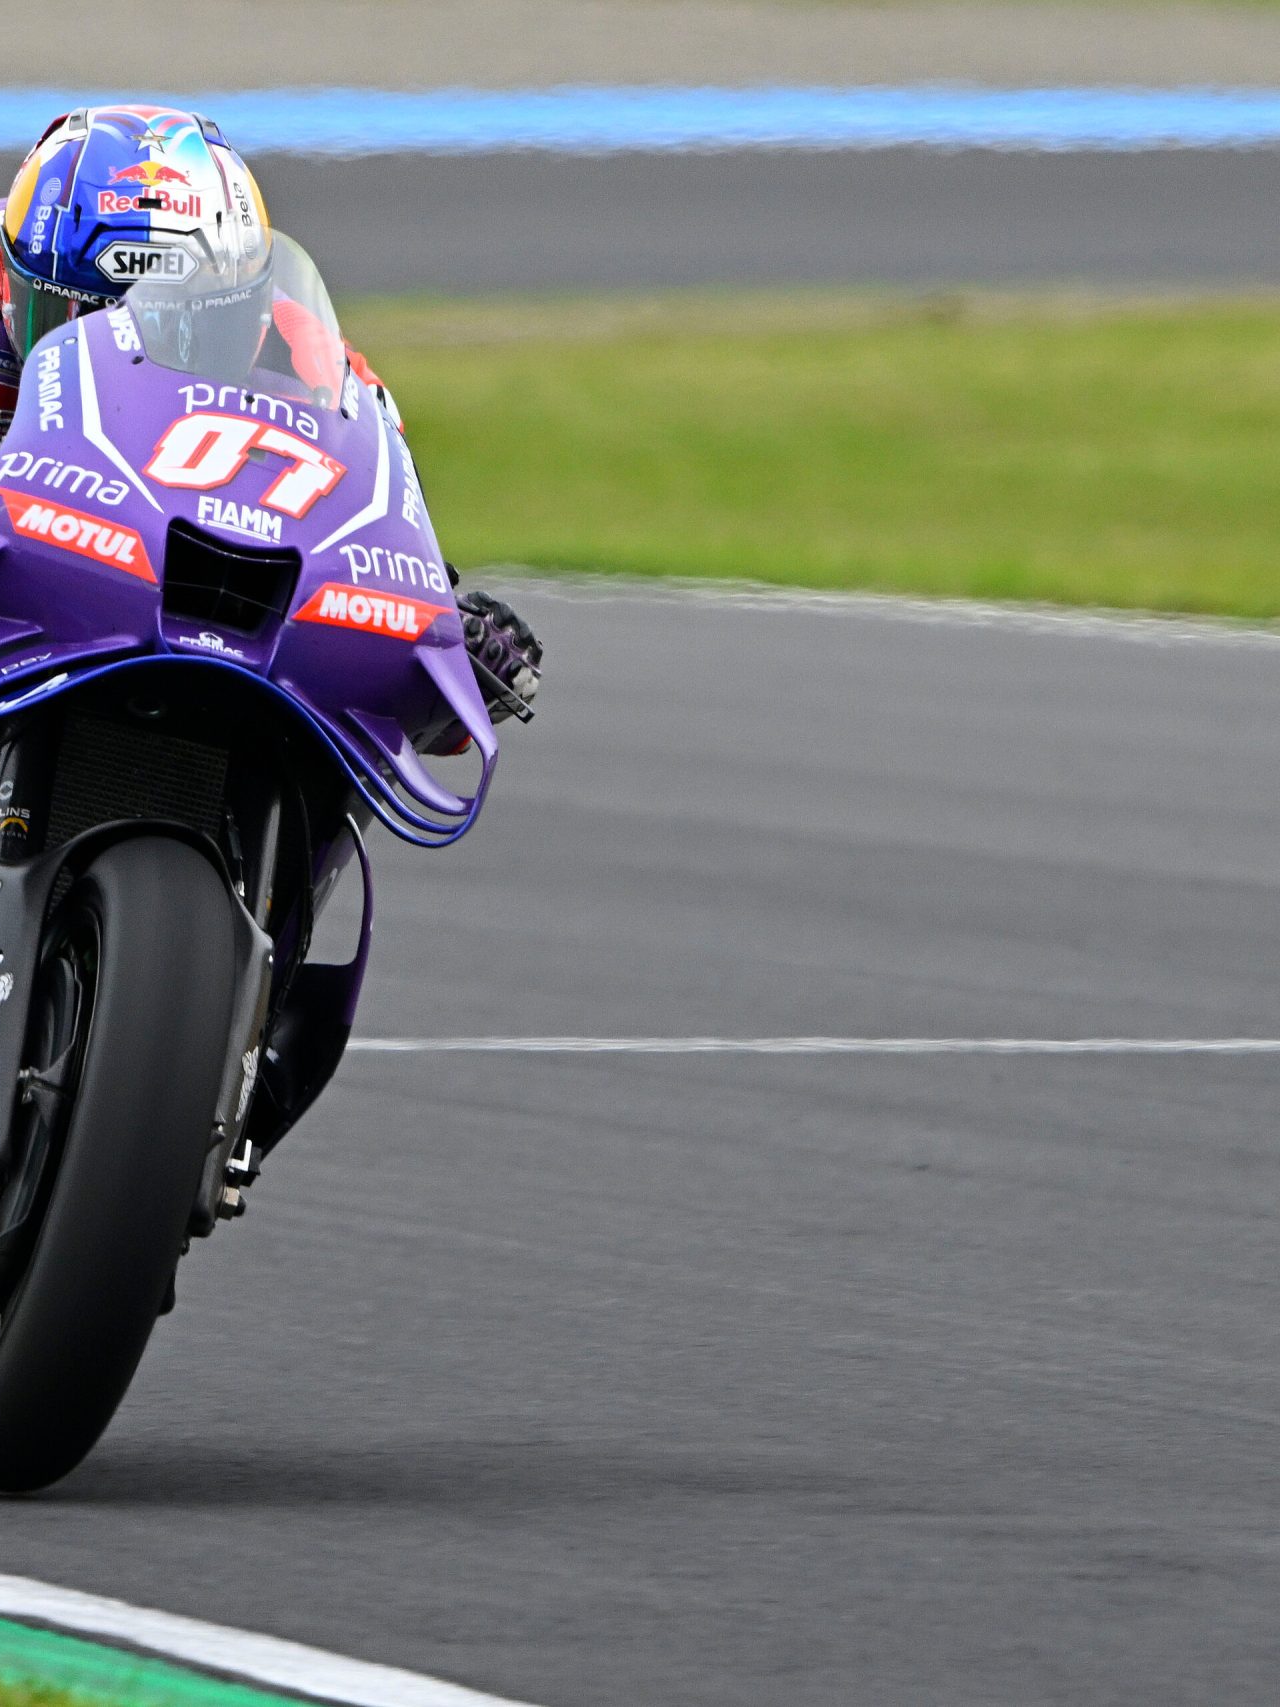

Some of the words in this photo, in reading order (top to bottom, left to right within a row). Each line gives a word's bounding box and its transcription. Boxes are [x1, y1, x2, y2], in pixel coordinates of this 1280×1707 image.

[98, 188, 149, 214] Red
[155, 189, 202, 218] Bull
[232, 182, 252, 227] Beta
[29, 205, 52, 255] Beta
[113, 250, 185, 276] SHOEI
[43, 283, 100, 305] PRAMAC
[204, 289, 253, 310] PRAMAC
[37, 345, 65, 432] PRAMAC
[177, 382, 320, 441] prima
[144, 411, 347, 519] 07
[16, 506, 137, 564] MOTUL
[197, 496, 283, 543] FIAMM
[339, 543, 447, 594] prima
[318, 588, 420, 635] MOTUL
